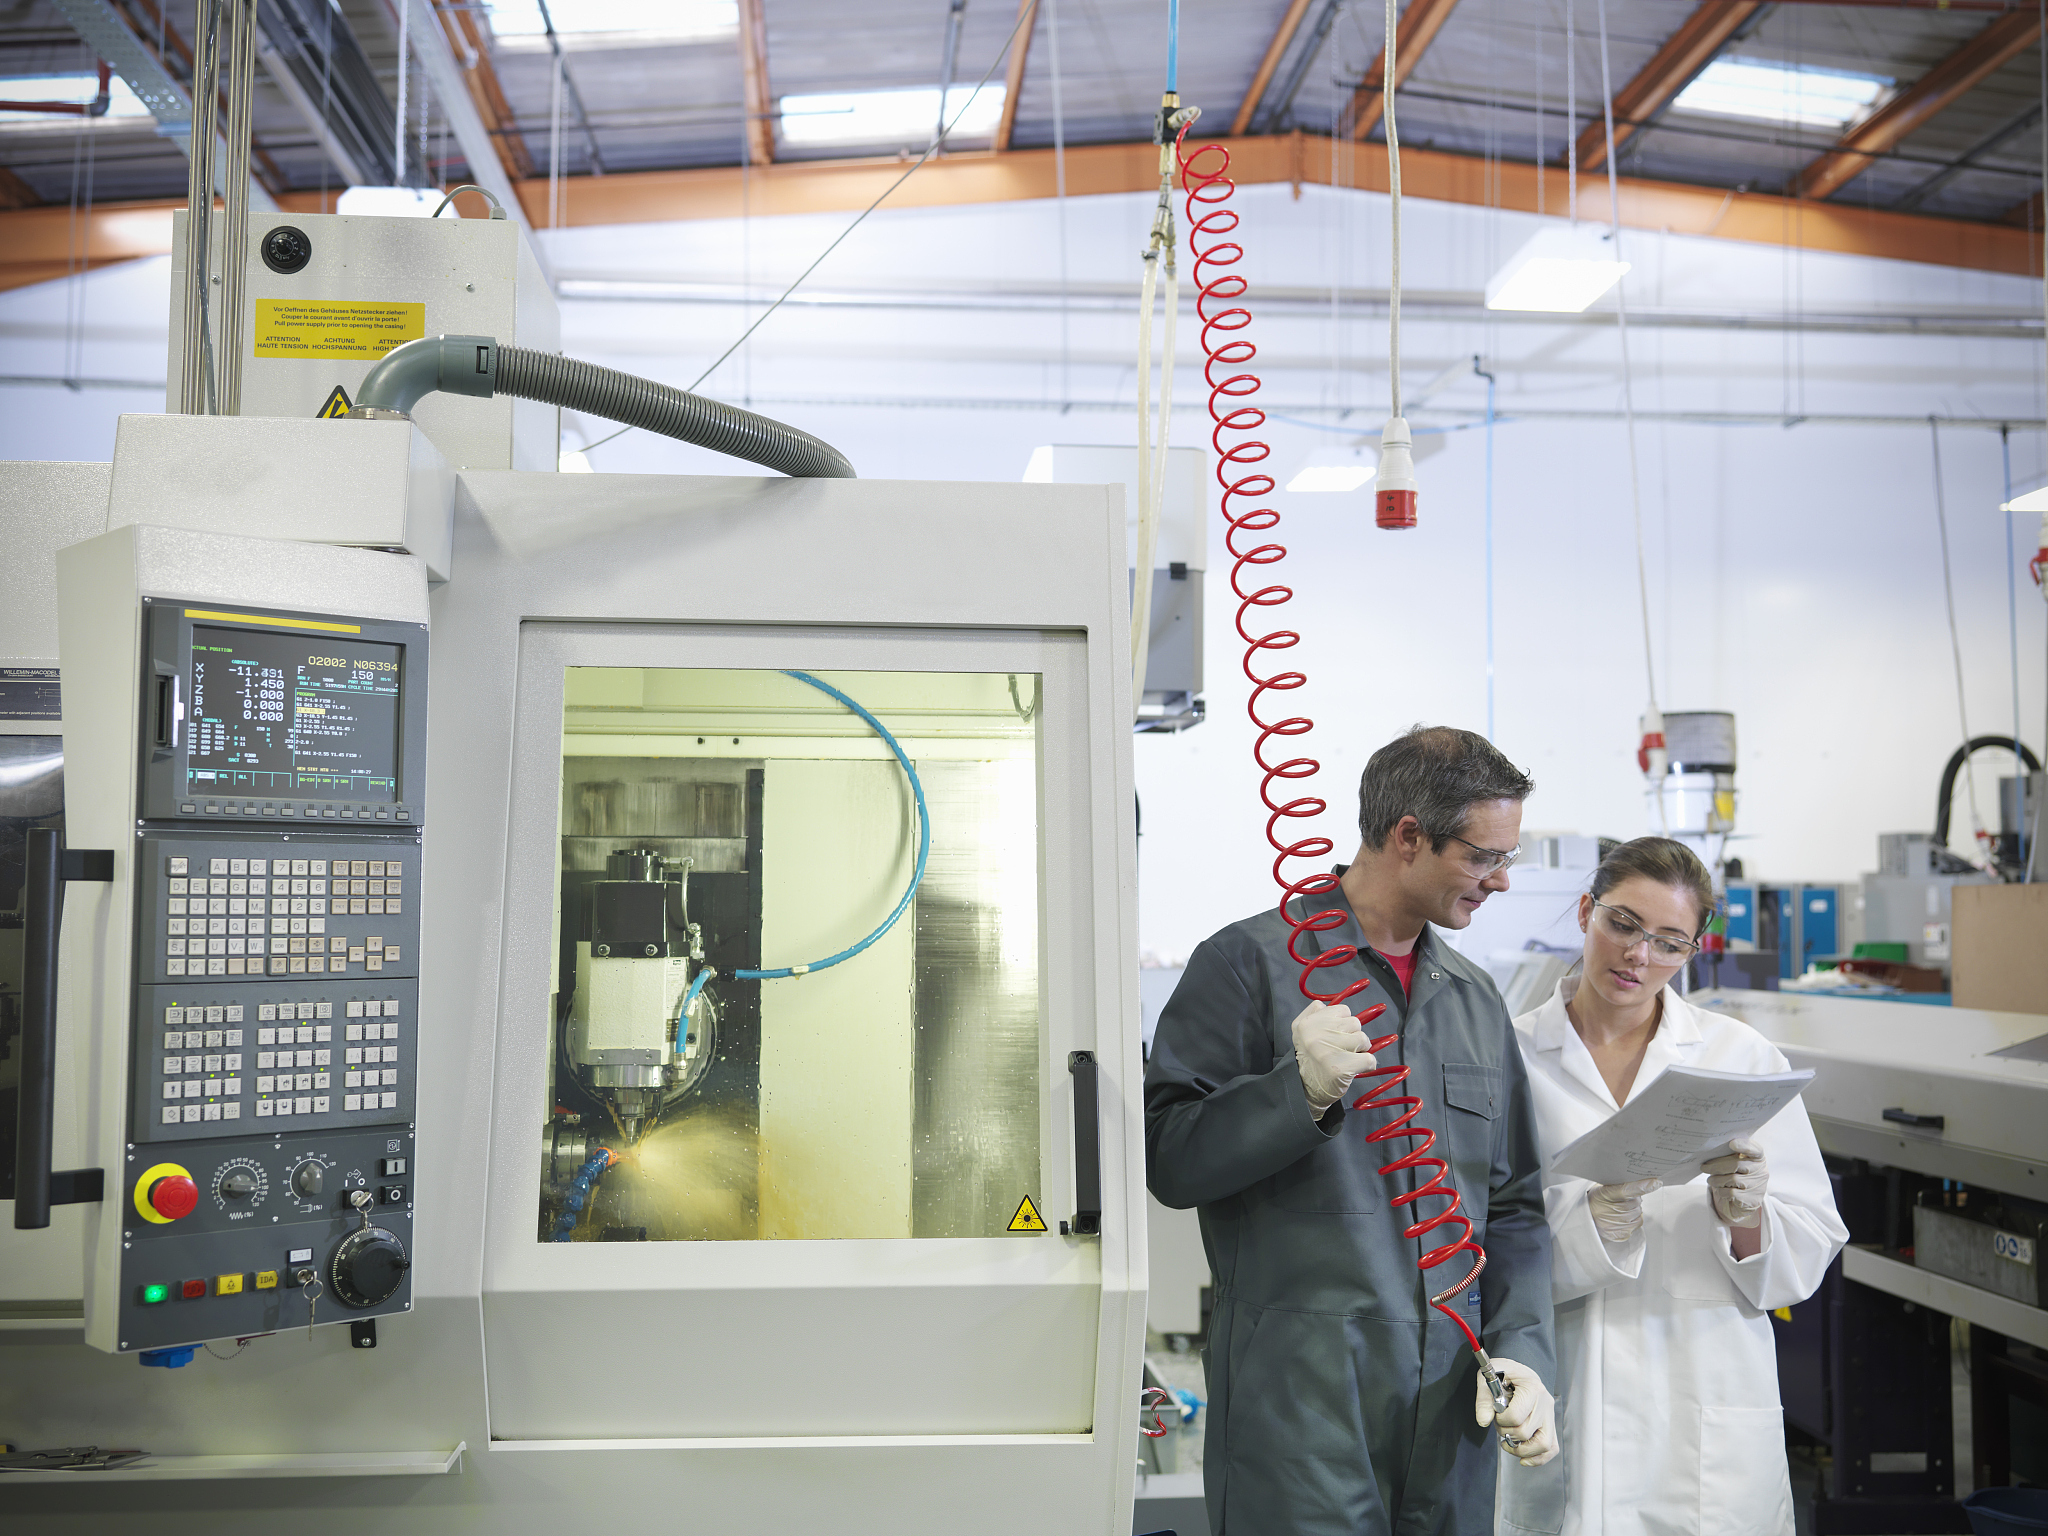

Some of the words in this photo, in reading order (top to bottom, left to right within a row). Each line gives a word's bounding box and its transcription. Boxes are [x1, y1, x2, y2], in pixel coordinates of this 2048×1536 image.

[196, 663, 204, 672] X
[297, 666, 305, 674] F
[351, 670, 373, 680] 150
[354, 660, 398, 672] N06394
[196, 674, 204, 683] Y
[245, 678, 284, 689] 1.450
[195, 684, 203, 694] Z
[236, 688, 284, 700] -1.000
[195, 696, 203, 705] B
[244, 699, 284, 711] 0.000
[194, 707, 203, 716] A
[243, 710, 283, 721] 0.000
[260, 1275, 274, 1284] IDA
